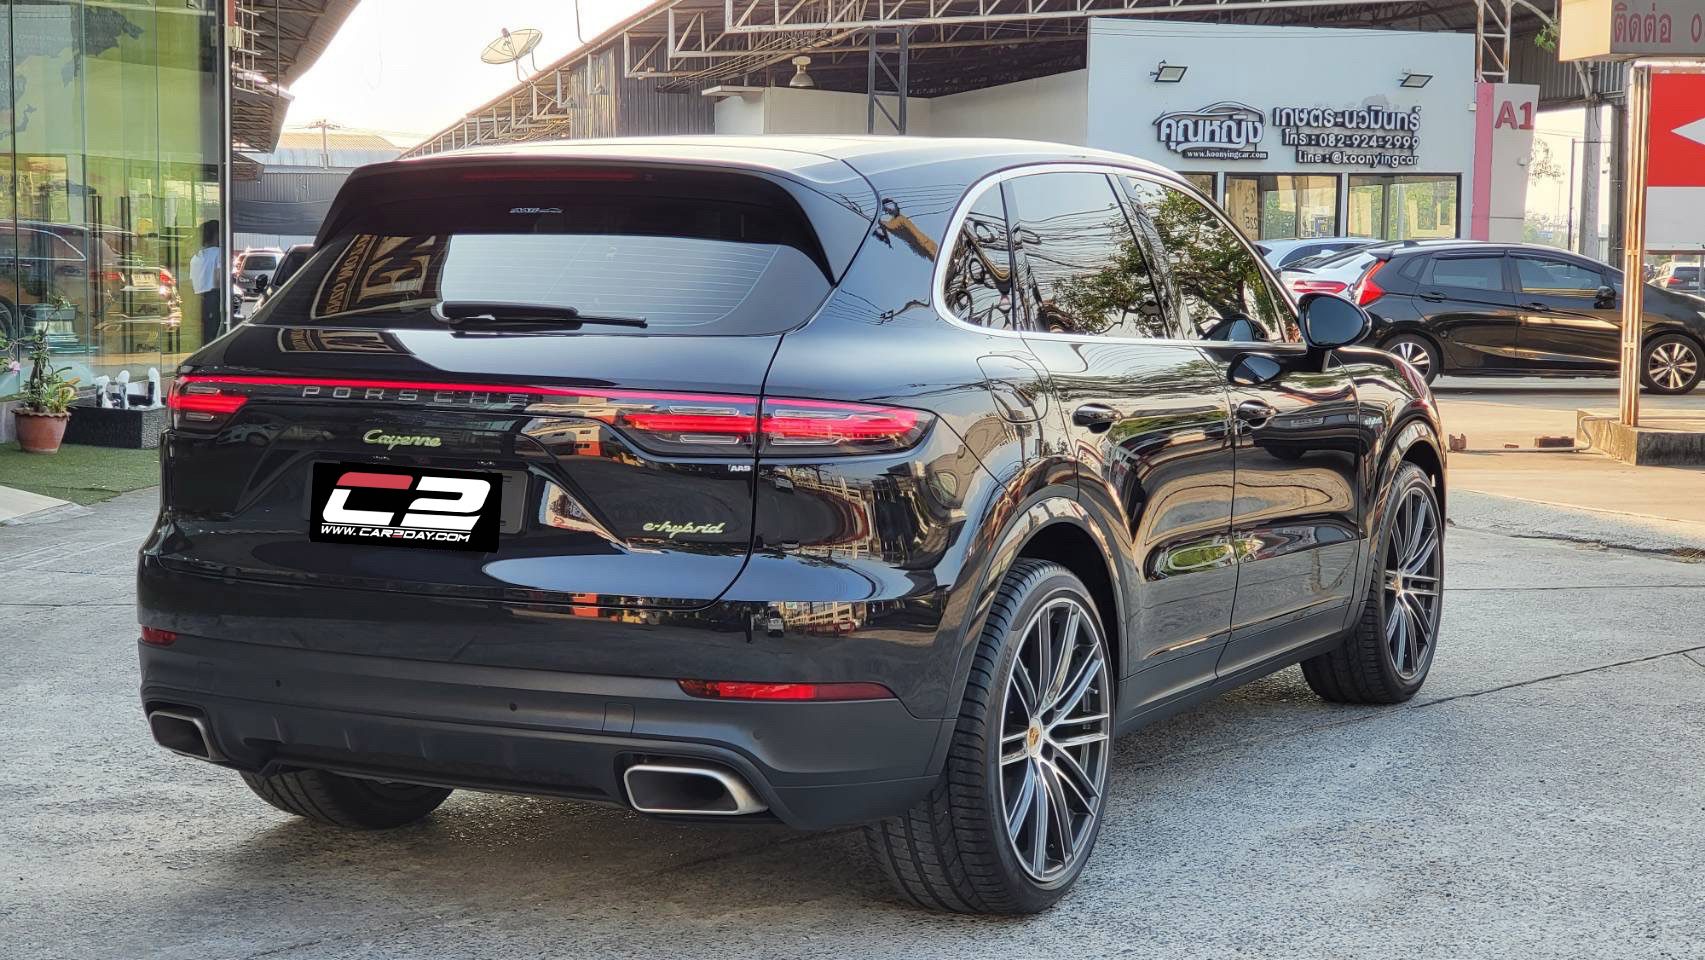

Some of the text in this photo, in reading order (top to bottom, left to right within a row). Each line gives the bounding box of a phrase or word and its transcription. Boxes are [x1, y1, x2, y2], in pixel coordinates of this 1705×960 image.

[1614, 3, 1671, 42] ติดต่อ
[1273, 106, 1421, 130] เกษตร-นวมินทร์
[1495, 101, 1534, 129] A1
[1159, 114, 1263, 152] คุณหญิง
[1319, 133, 1420, 149] 082-924-2999
[1187, 150, 1267, 159] www.koonyingcar.com
[302, 386, 530, 406] PORSCHE
[363, 429, 442, 450] Cayenne
[643, 521, 726, 539] e-hybrid
